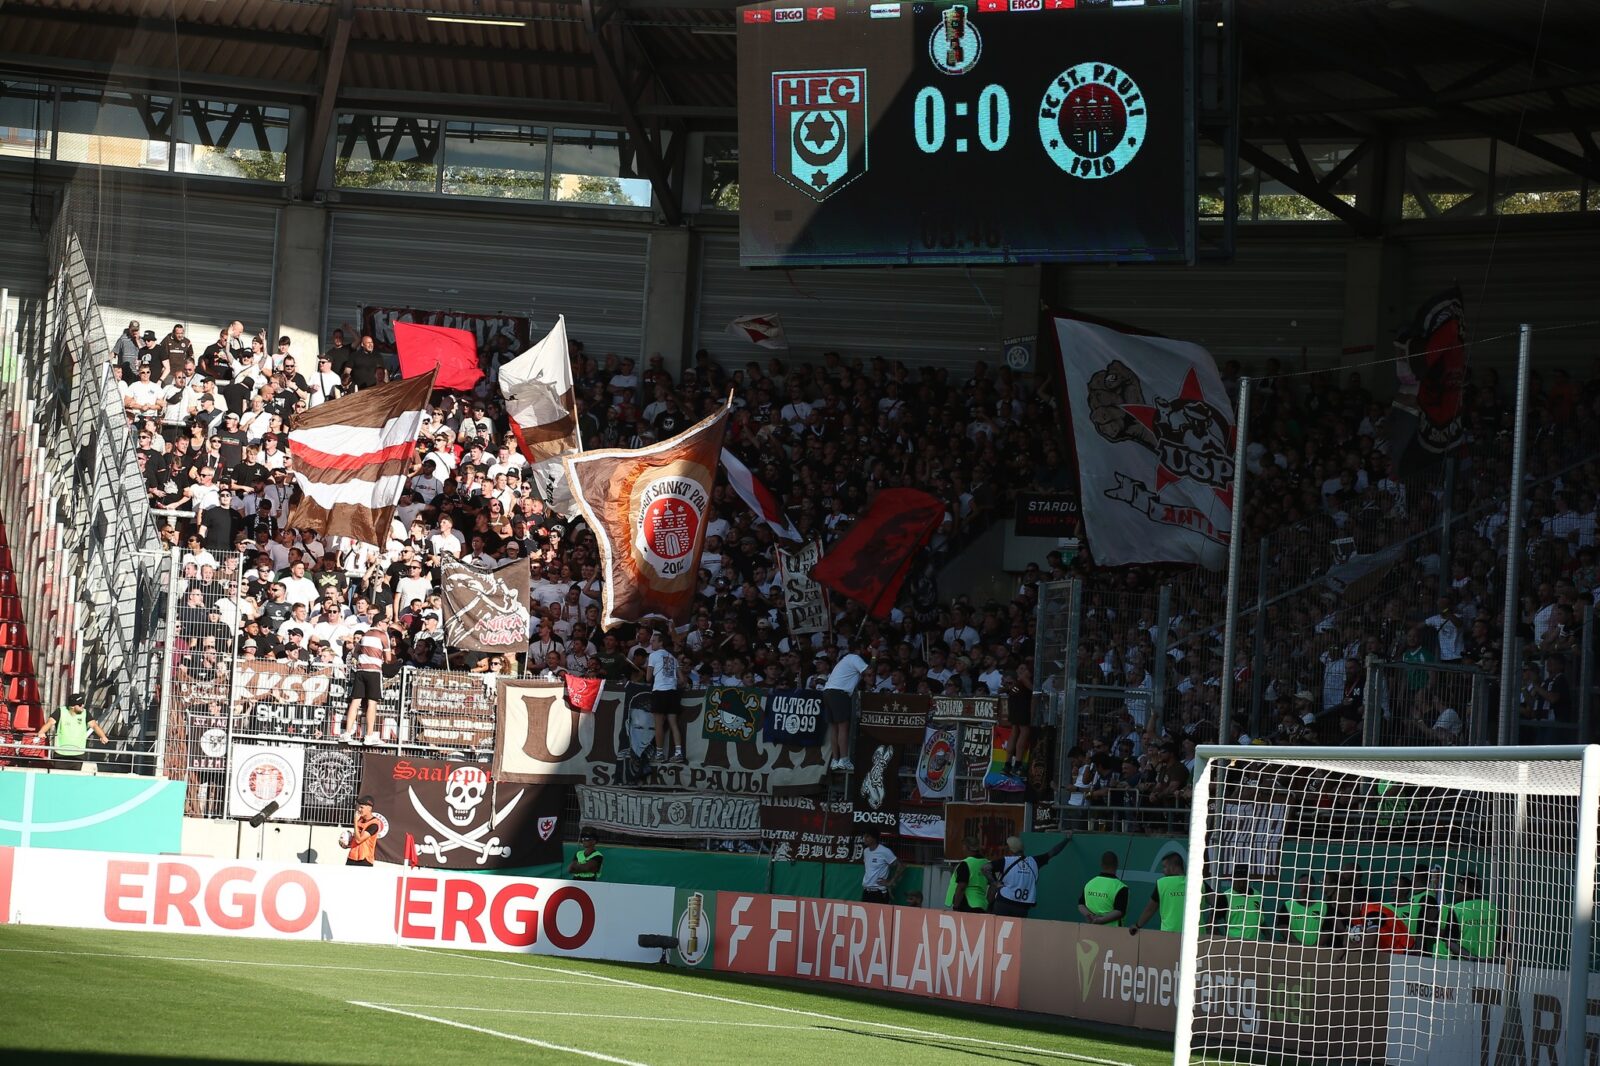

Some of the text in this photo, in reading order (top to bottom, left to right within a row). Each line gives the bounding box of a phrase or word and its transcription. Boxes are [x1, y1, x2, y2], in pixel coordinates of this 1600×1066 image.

[775, 10, 802, 21] ERGO
[780, 77, 855, 105] HFC
[1041, 93, 1061, 120] FC
[1093, 64, 1145, 117] PAULI
[914, 84, 1011, 153] 0:0
[1070, 156, 1116, 177] 1910
[1160, 442, 1235, 488] USP
[652, 480, 692, 497] SANKT
[772, 695, 822, 716] ULTRAS
[861, 715, 926, 726] SMILEY FACES
[592, 764, 770, 794] SKT PAULI
[582, 789, 665, 829] ENFANTS
[104, 859, 321, 933] ERGO
[1014, 888, 1029, 900] 08
[394, 876, 596, 950] ERGO
[767, 898, 986, 1001] FLYERALARM
